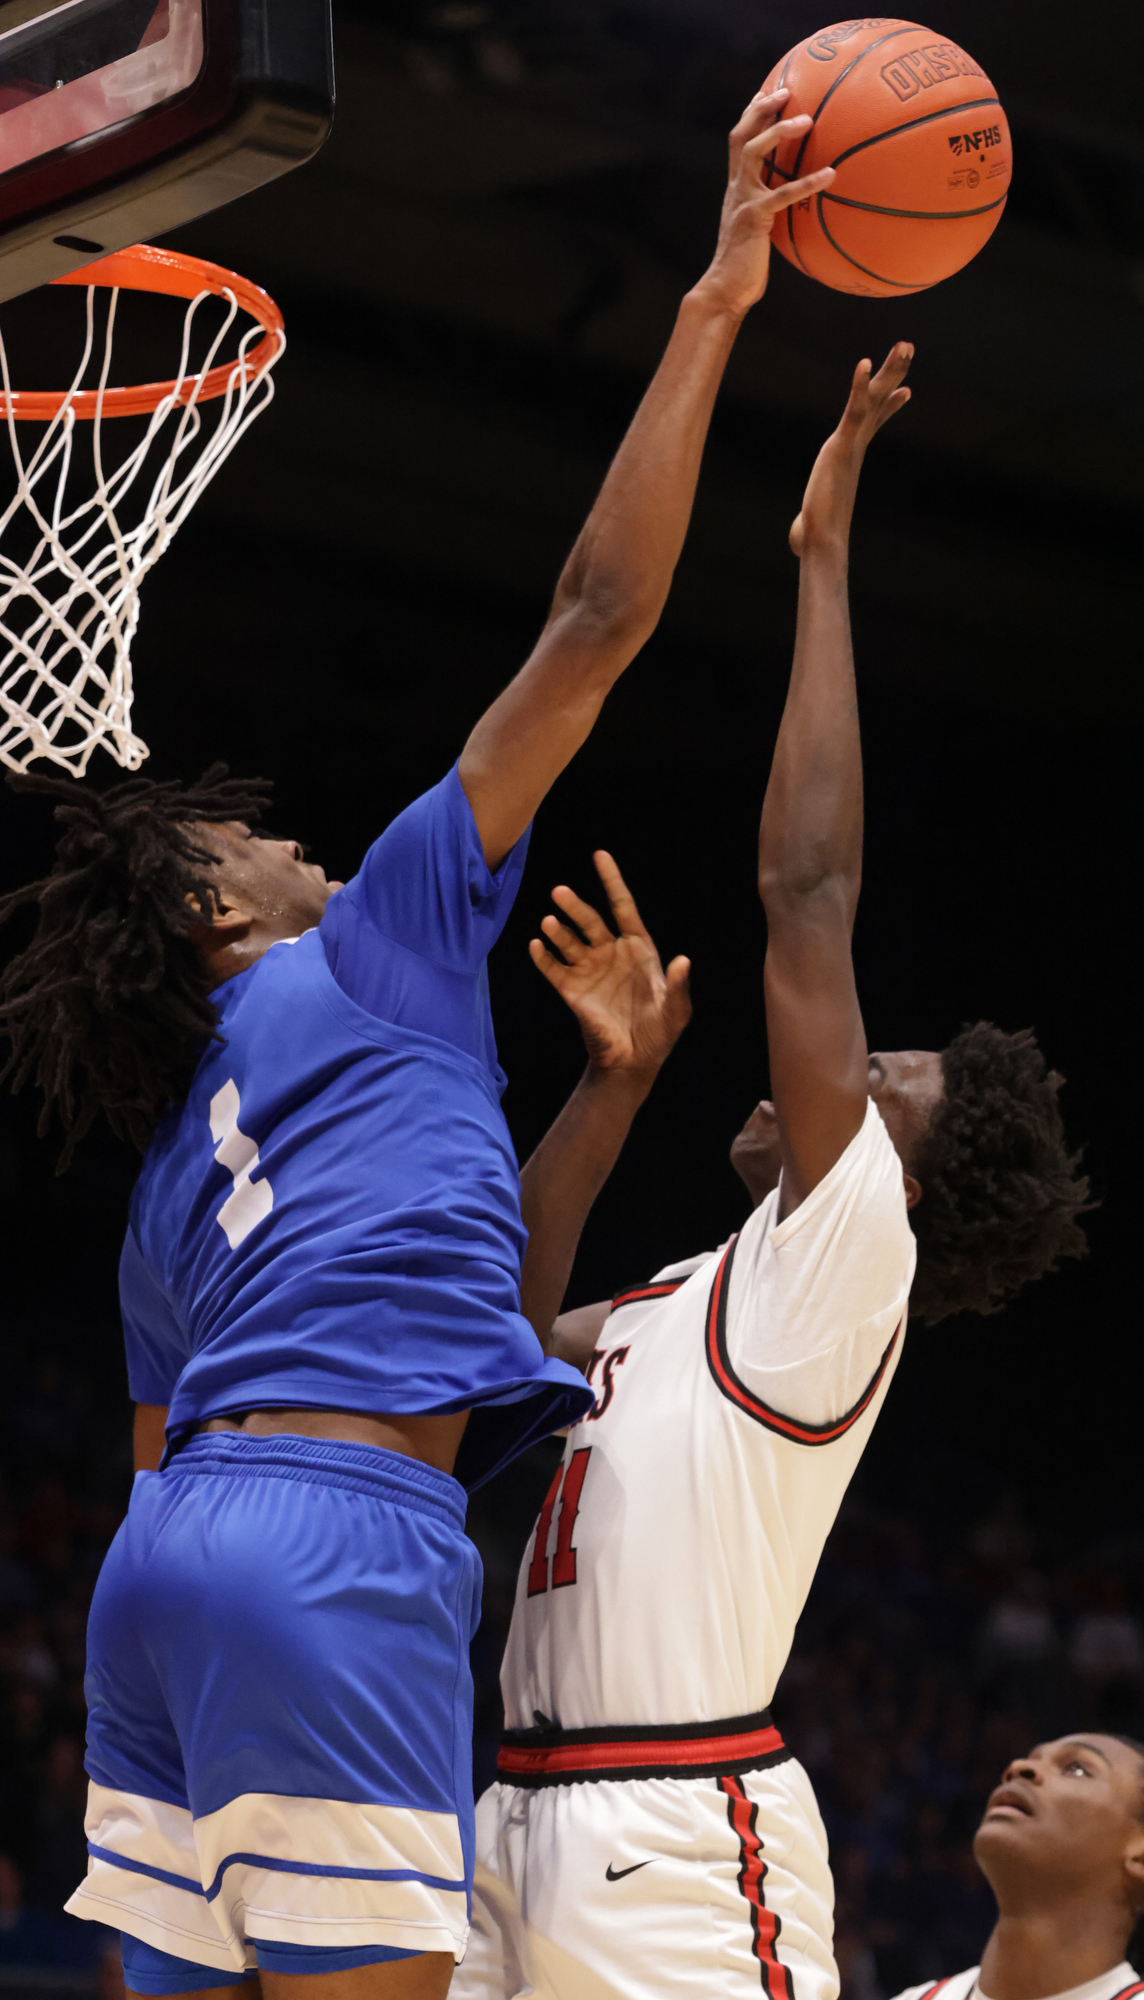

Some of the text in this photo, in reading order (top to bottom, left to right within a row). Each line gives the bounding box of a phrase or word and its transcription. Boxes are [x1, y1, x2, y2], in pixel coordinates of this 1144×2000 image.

[962, 125, 1001, 153] NFHS
[209, 1078, 273, 1251] 1
[527, 1446, 593, 1598] 11
